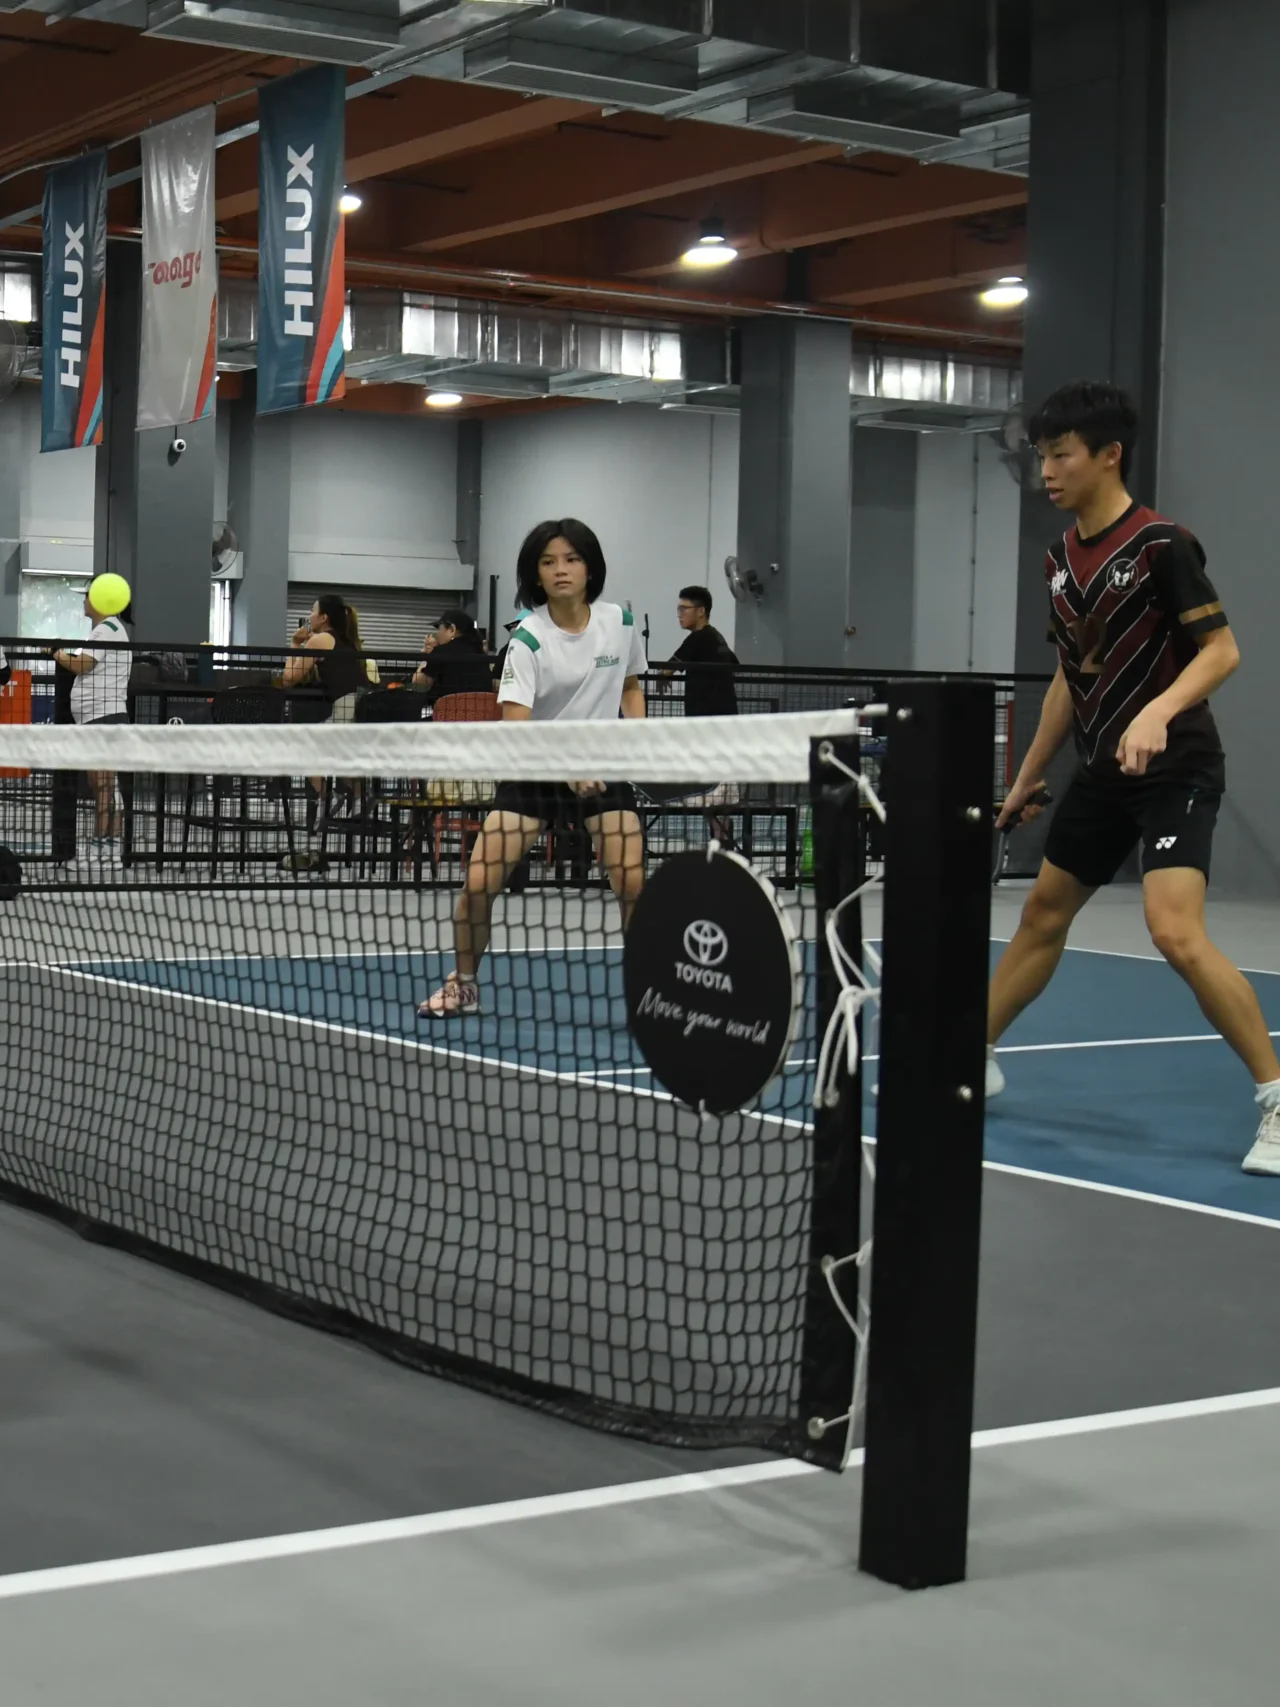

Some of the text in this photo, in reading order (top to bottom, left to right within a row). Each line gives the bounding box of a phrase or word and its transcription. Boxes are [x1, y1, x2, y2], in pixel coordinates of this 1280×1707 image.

[284, 143, 315, 337] HILUX
[60, 220, 85, 389] HILUX
[636, 986, 771, 1045] Move your world
[674, 961, 734, 994] TOYOTA
